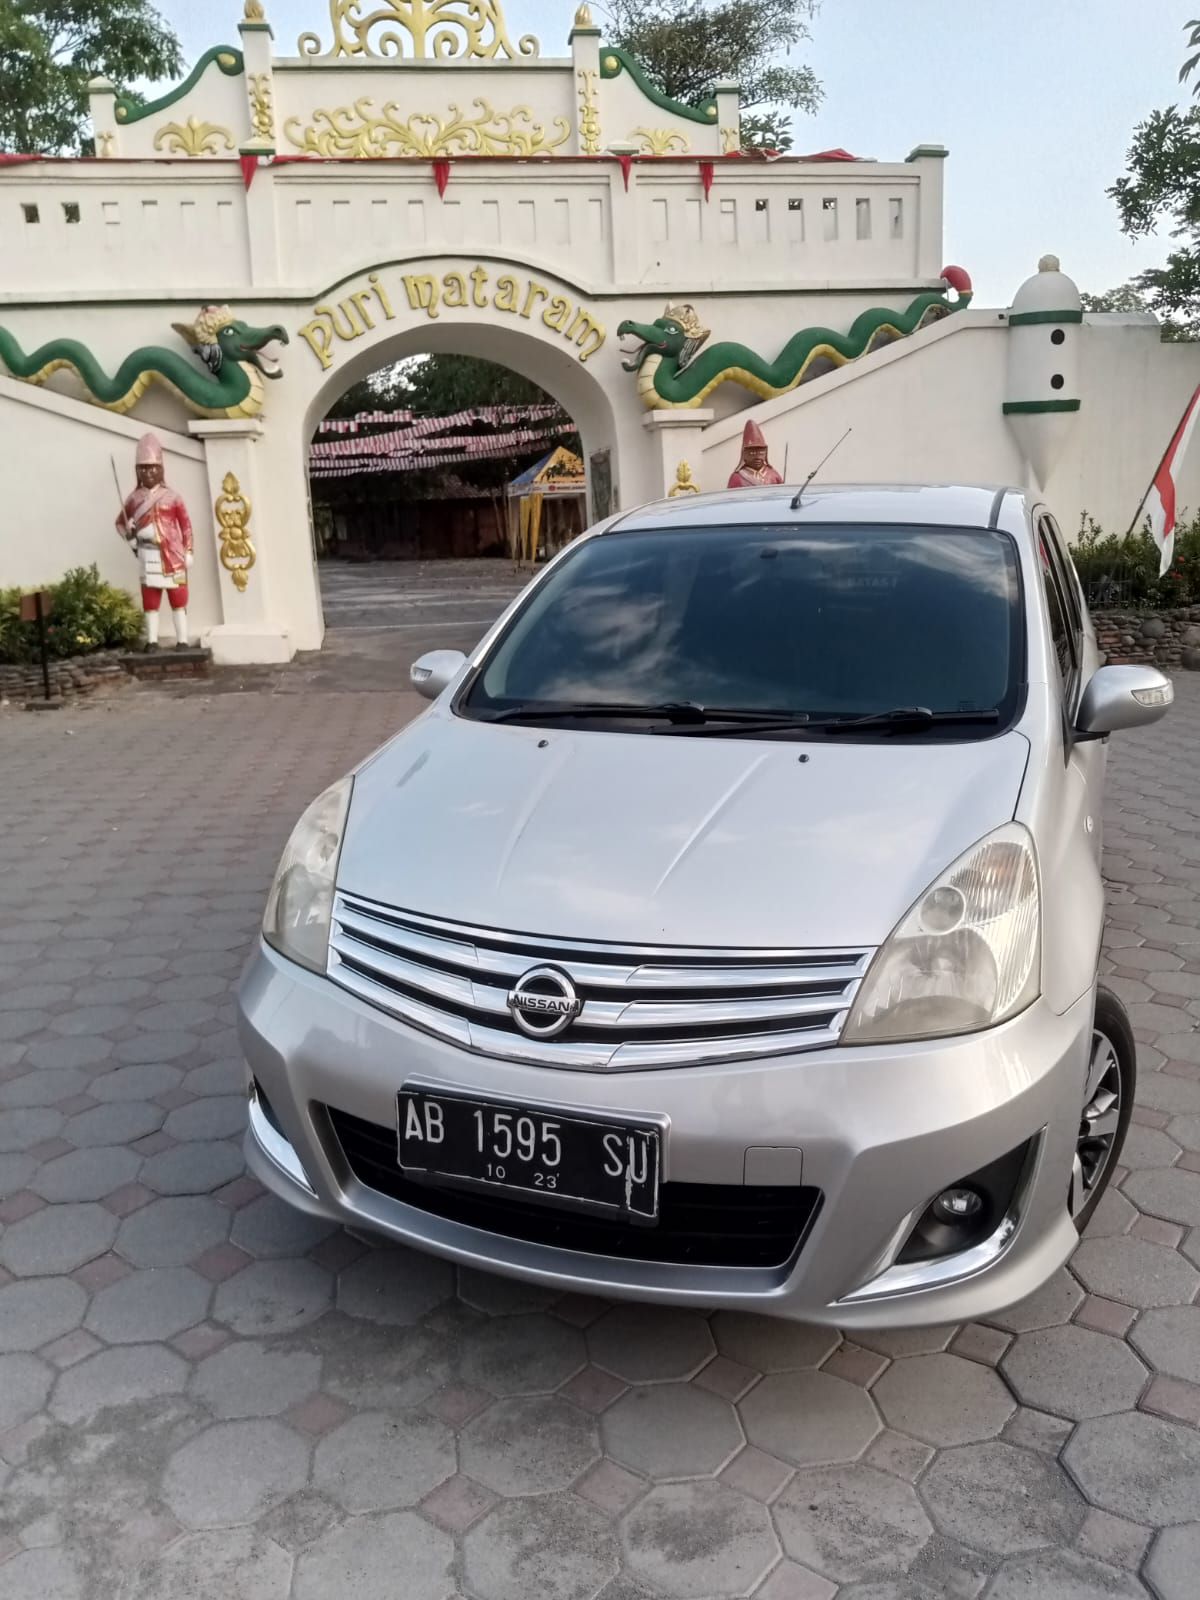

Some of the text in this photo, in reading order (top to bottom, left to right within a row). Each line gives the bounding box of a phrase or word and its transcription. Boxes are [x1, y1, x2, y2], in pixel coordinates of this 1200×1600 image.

[513, 993, 571, 1013] NISSAN
[404, 1097, 649, 1185] AB 1595 SU
[487, 1163, 507, 1180] 10
